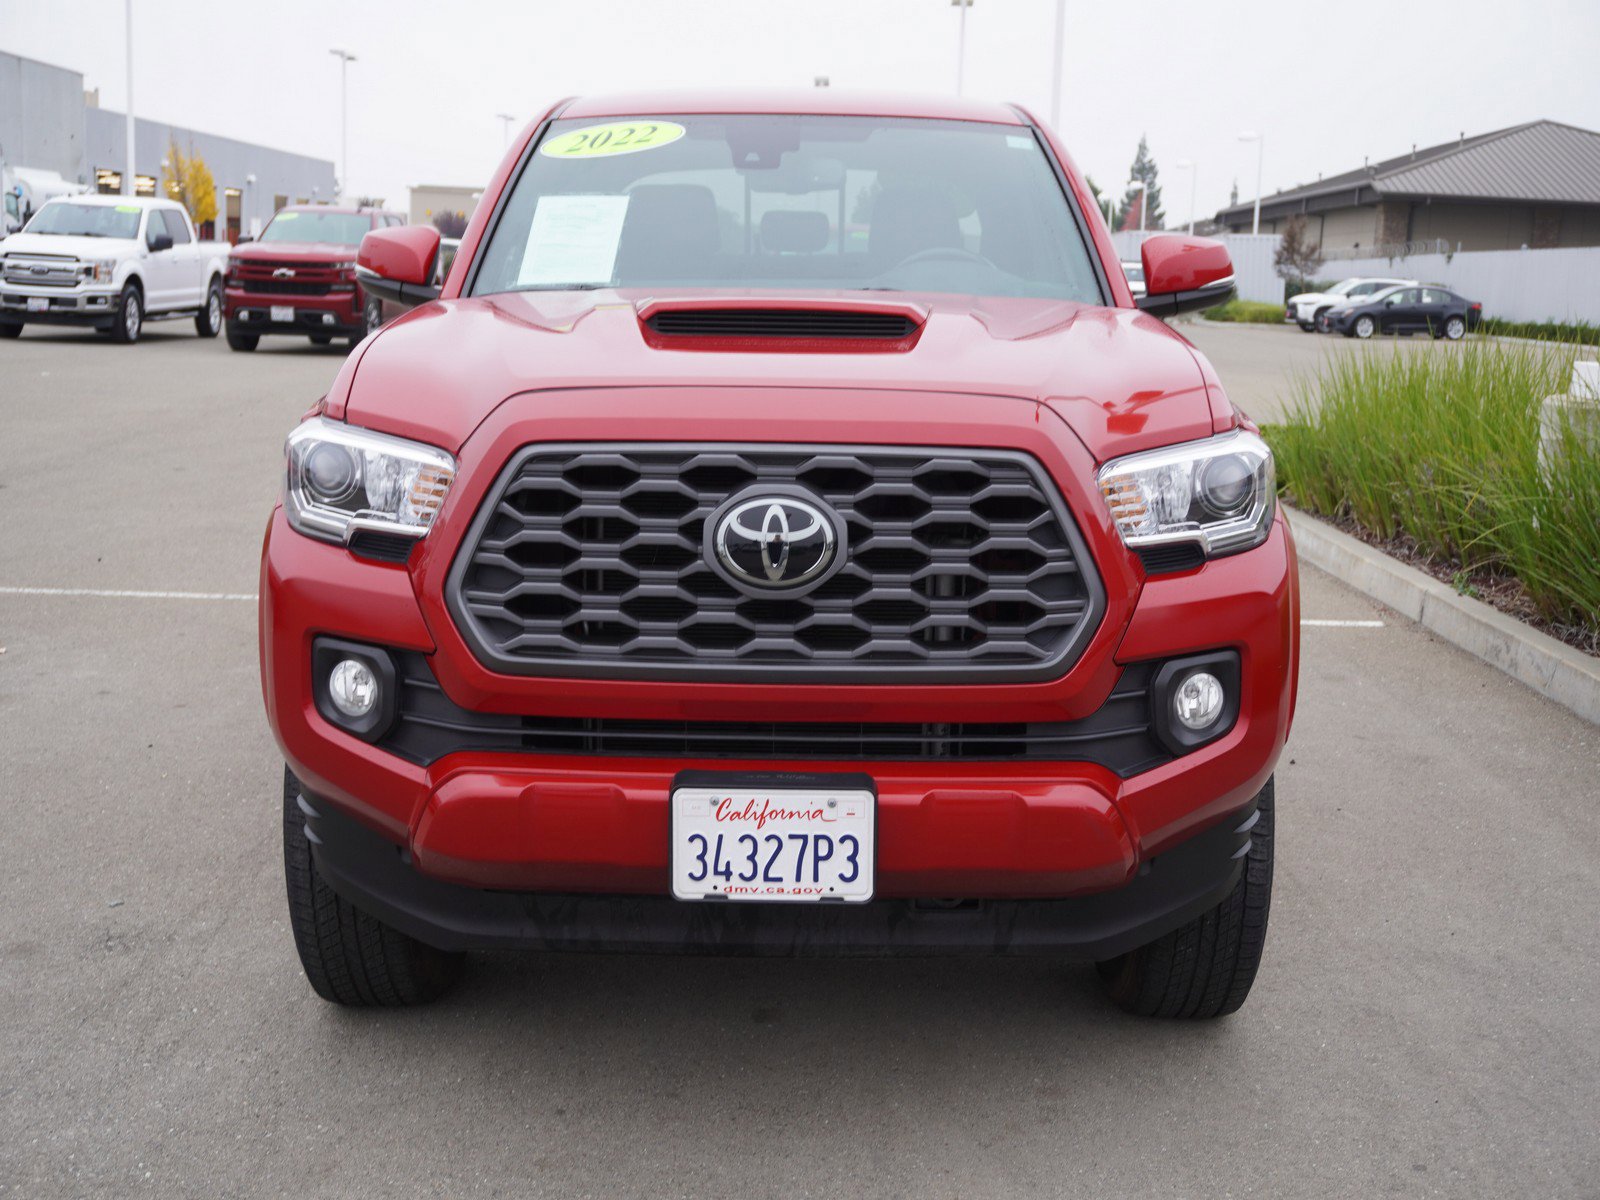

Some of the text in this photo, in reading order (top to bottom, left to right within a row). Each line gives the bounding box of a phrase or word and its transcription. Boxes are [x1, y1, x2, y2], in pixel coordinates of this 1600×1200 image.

[565, 125, 658, 153] 2022
[715, 797, 838, 830] California
[688, 833, 860, 883] 34327P3
[723, 885, 824, 895] dmv.ca.gov
